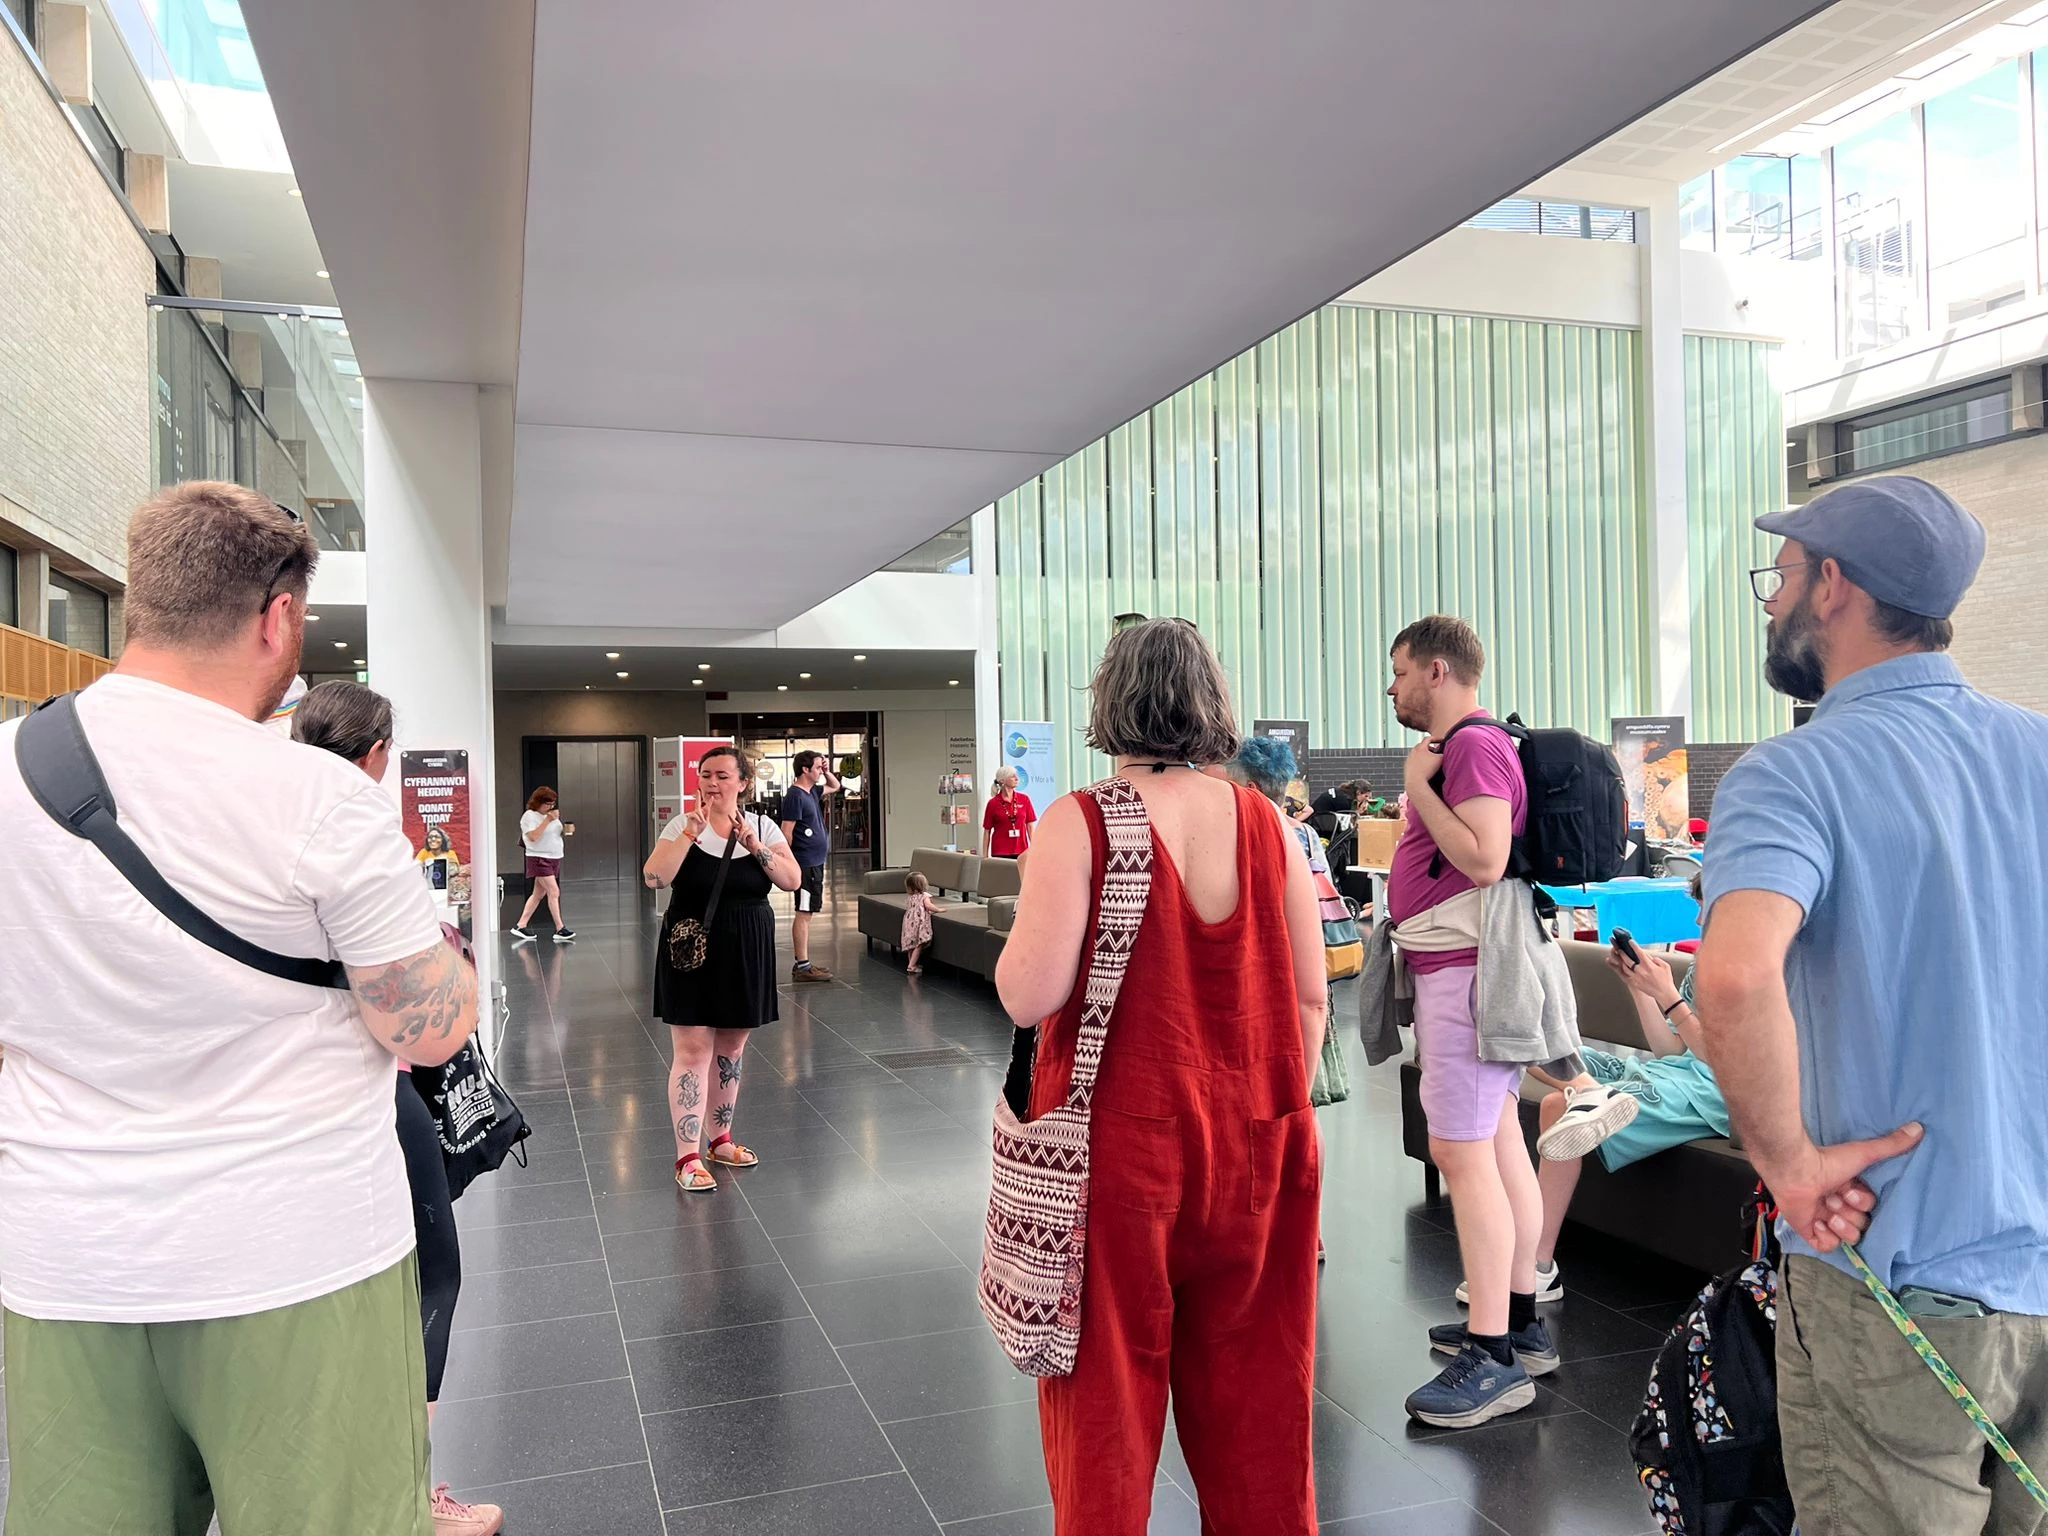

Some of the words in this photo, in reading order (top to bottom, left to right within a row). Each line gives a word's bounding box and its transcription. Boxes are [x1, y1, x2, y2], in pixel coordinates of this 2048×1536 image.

[404, 776, 466, 787] CYFRANNWCH
[417, 787, 453, 797] HEDDIW
[418, 803, 454, 813] DONATE
[421, 814, 451, 824] TODAY
[447, 1068, 487, 1112] NUJ
[434, 1118, 444, 1131] 30
[455, 1130, 487, 1154] fighting
